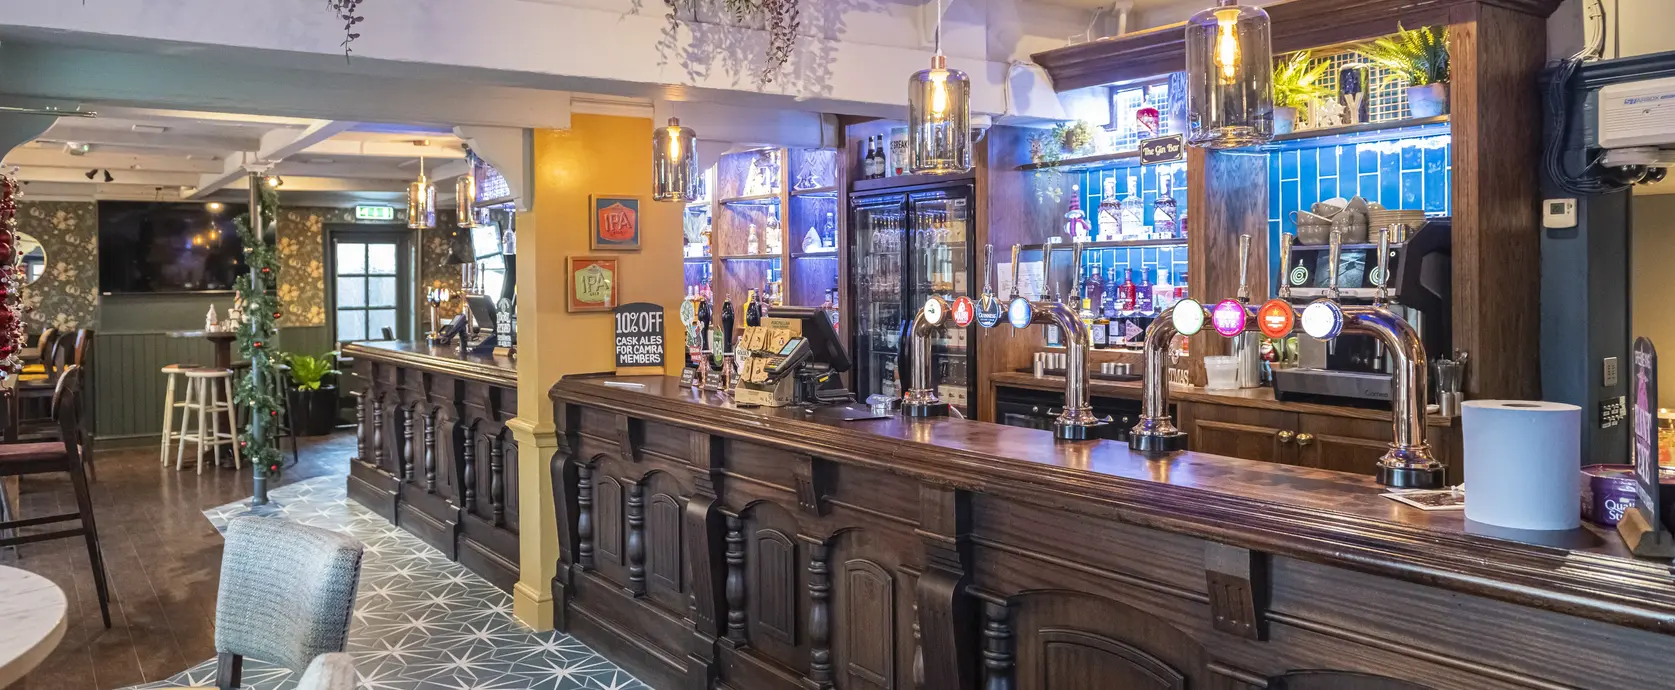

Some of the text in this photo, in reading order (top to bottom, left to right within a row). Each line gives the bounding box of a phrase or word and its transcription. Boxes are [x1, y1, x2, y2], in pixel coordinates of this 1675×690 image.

[1143, 143, 1179, 156] The Gin Bar
[603, 211, 632, 232] IPA
[581, 272, 609, 293] IPA
[616, 311, 663, 333] 10% OFF
[616, 335, 663, 346] CASK ALES
[616, 345, 664, 355] FOR CAMRA
[620, 354, 661, 364] MEMBERS
